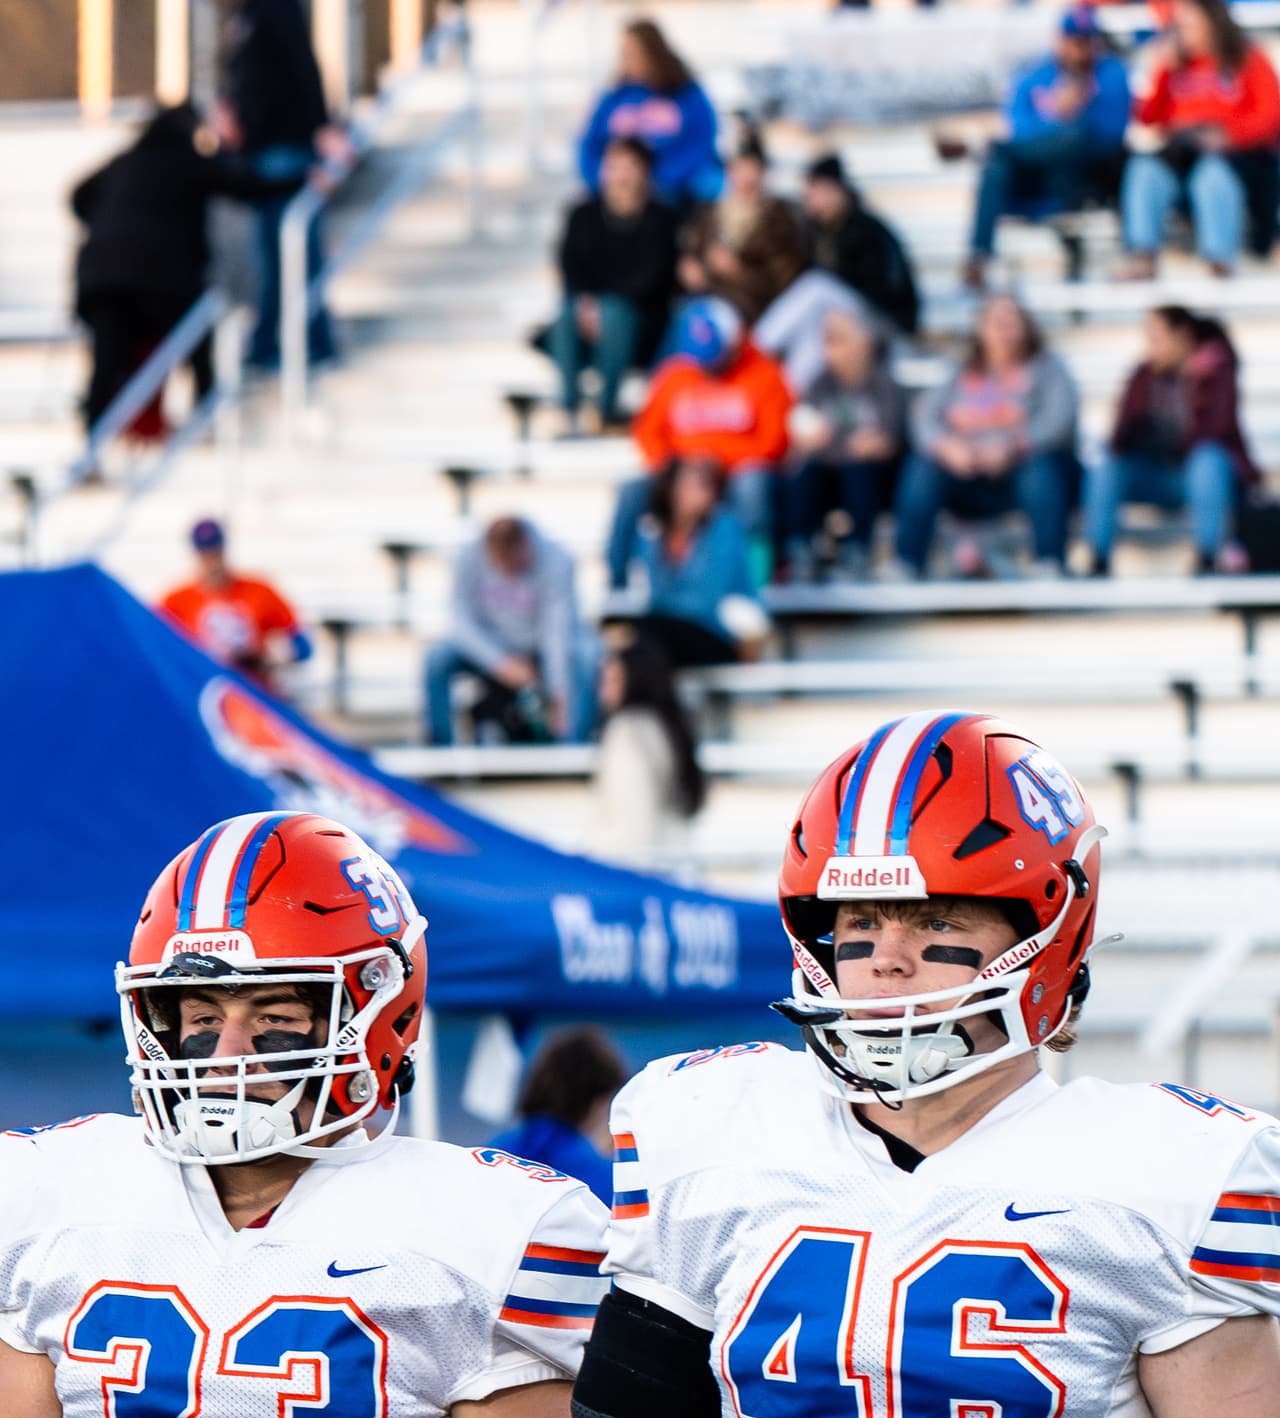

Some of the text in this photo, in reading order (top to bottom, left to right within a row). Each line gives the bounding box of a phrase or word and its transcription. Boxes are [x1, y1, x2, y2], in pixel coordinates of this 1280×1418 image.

[826, 866, 911, 888] Riddell
[172, 937, 241, 956] Riddell
[980, 938, 1041, 981] Riddell
[199, 1105, 236, 1117] Riddell
